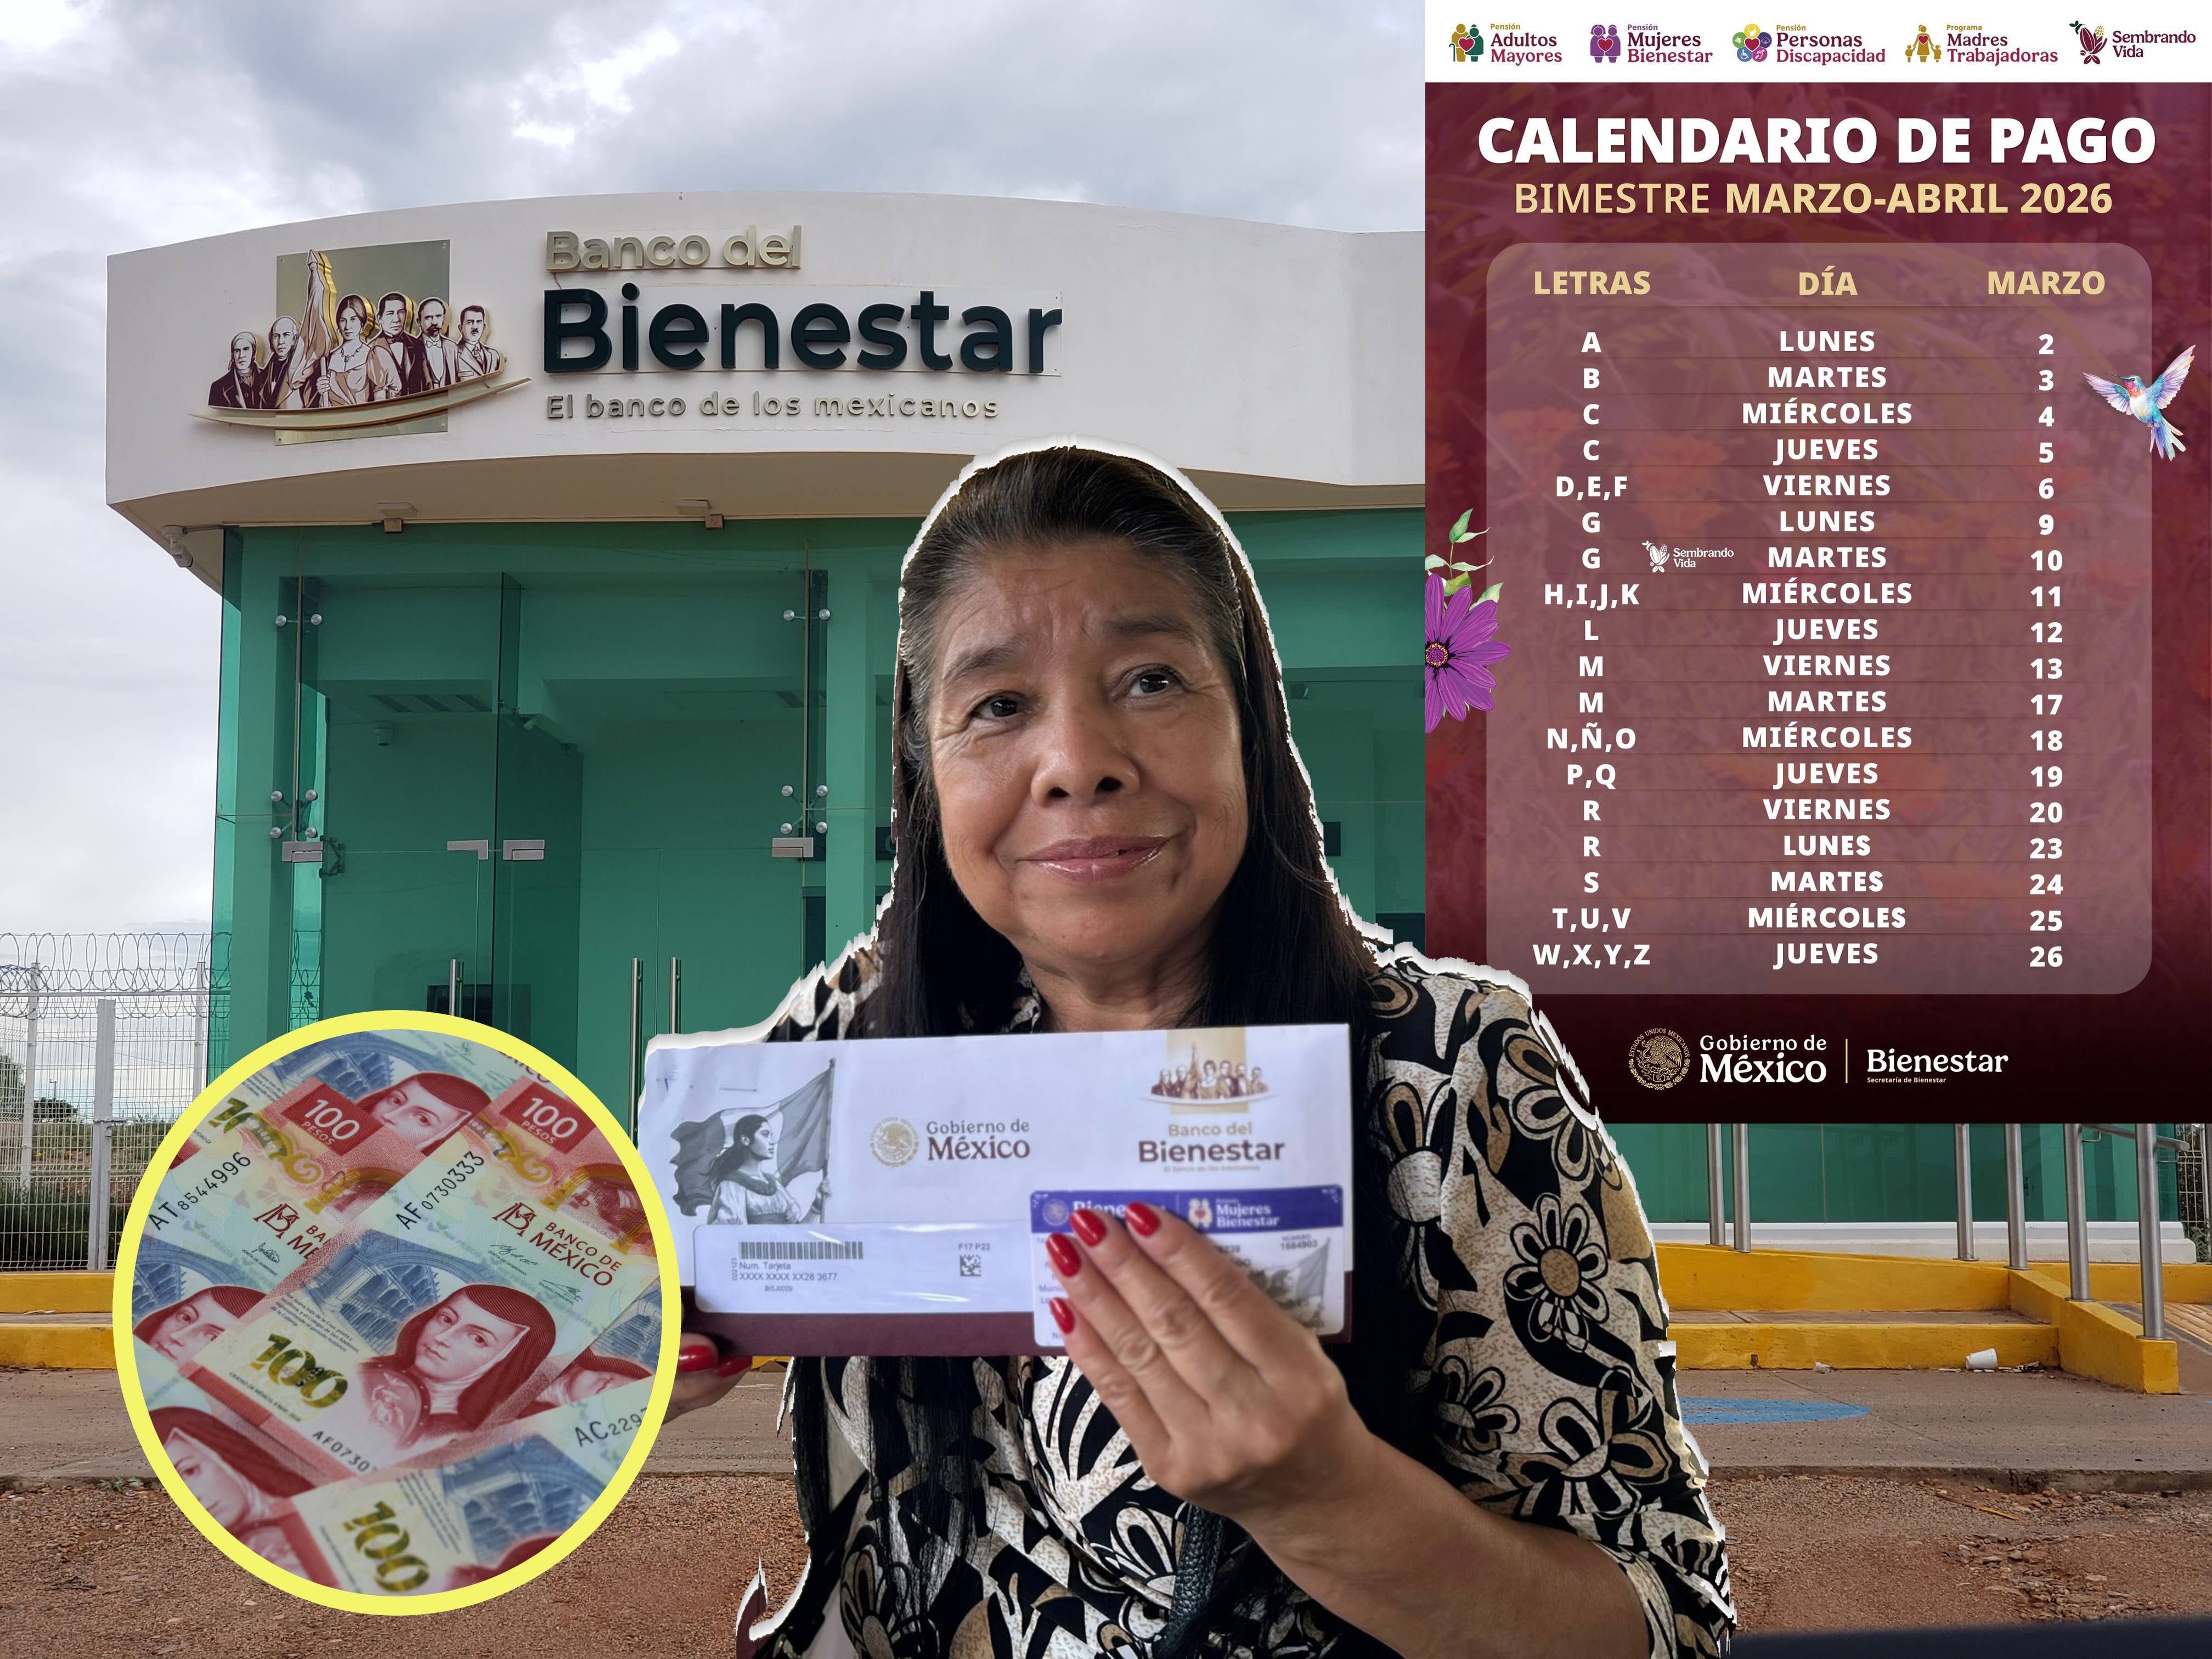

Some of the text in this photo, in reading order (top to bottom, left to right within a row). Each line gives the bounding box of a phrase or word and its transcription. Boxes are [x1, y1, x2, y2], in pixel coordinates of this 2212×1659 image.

[546, 225, 802, 270] Banco del
[544, 283, 1062, 373] Bienestar
[547, 391, 998, 419] El banco de los mexicanos
[304, 1099, 360, 1140] 100
[522, 1097, 578, 1138] 100
[927, 1118, 1030, 1135] Gobierno de
[1168, 1122, 1252, 1137] Banco del
[302, 1121, 335, 1145] PESOS
[521, 1121, 557, 1144] PESOS
[928, 1135, 1030, 1160] México
[1138, 1140, 1284, 1163] Bienestar
[1216, 1204, 1271, 1216] Mujeres
[1216, 1216, 1280, 1228] Bienestar
[529, 1232, 613, 1285] MÉXICO
[545, 1222, 622, 1271] BANCO DE
[250, 1333, 348, 1408] 100
[343, 1501, 430, 1593] 100
